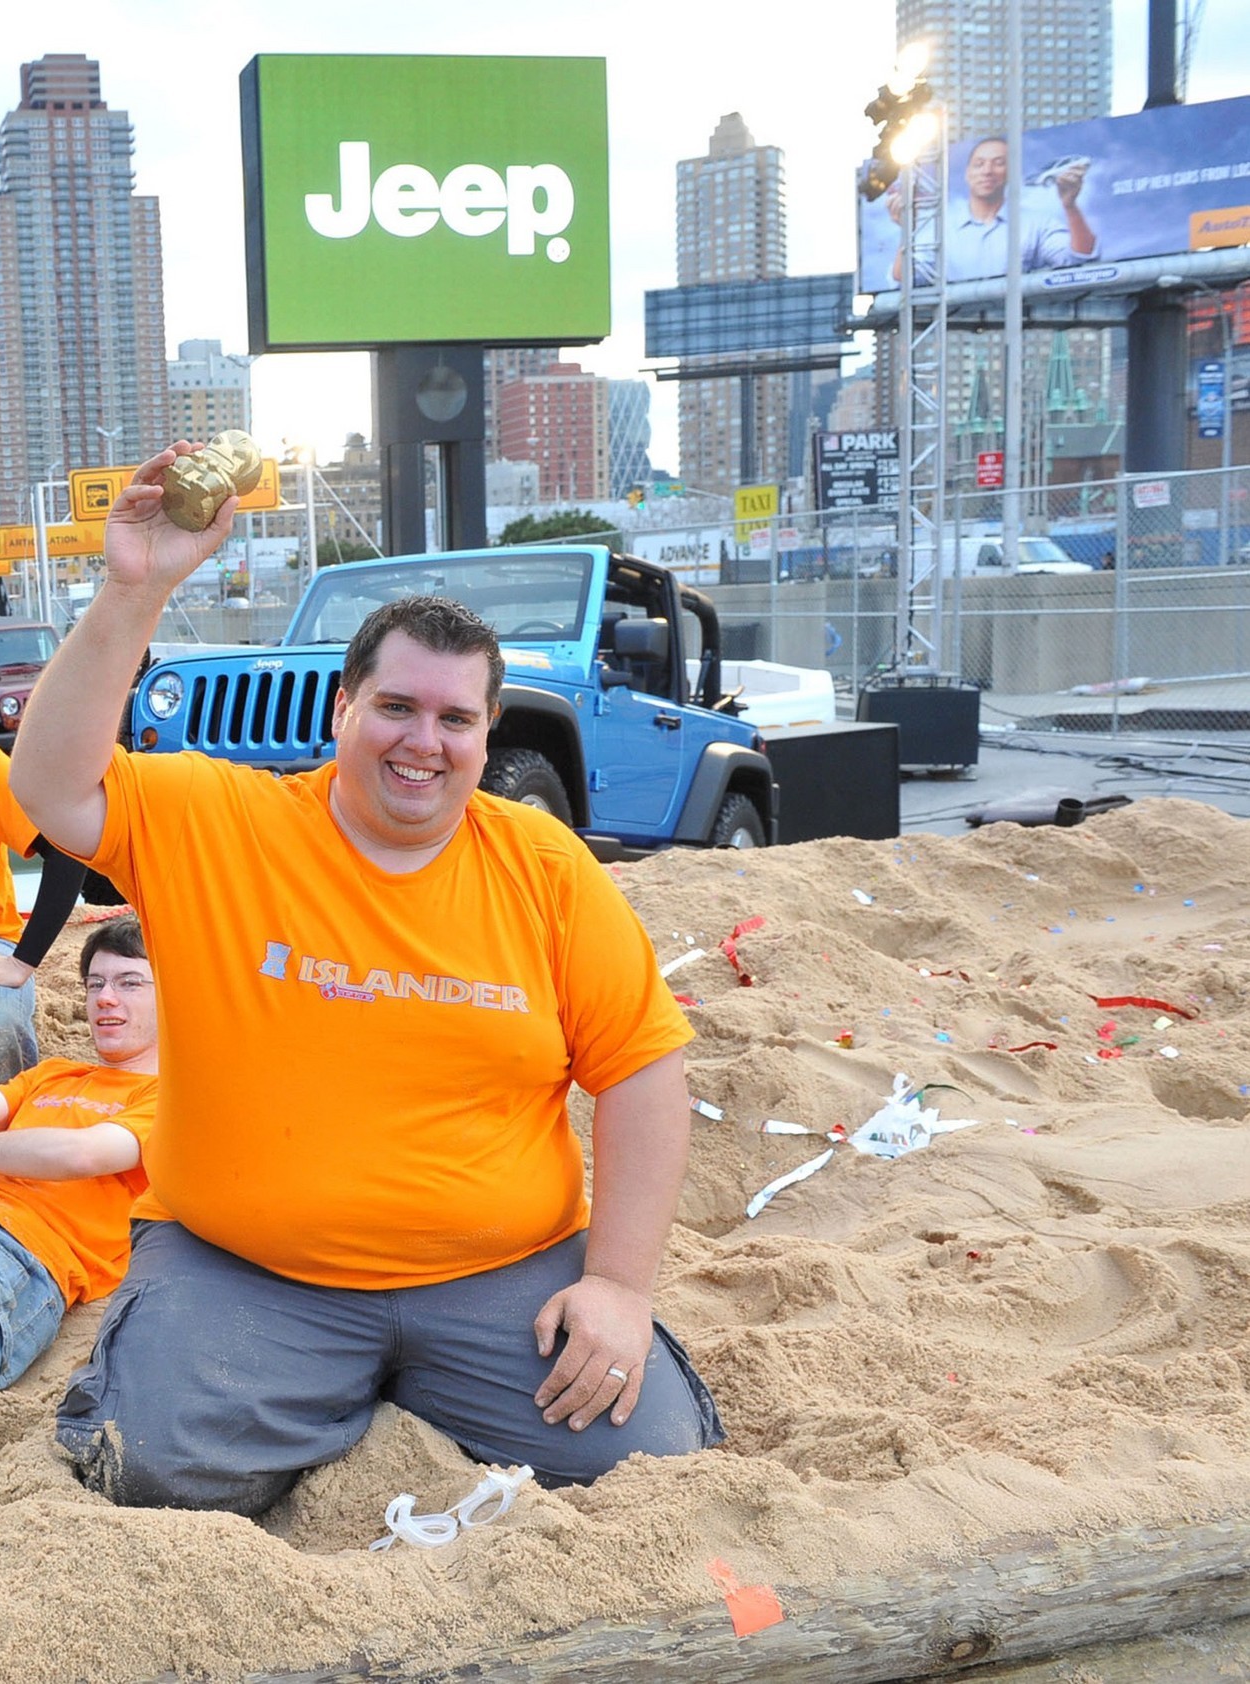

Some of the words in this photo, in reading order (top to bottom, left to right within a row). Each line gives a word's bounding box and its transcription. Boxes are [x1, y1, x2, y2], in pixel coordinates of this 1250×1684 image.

[841, 432, 897, 451] PARK
[740, 493, 771, 512] TAXI
[254, 659, 284, 671] Jeep
[298, 955, 530, 1013] ISLANDER
